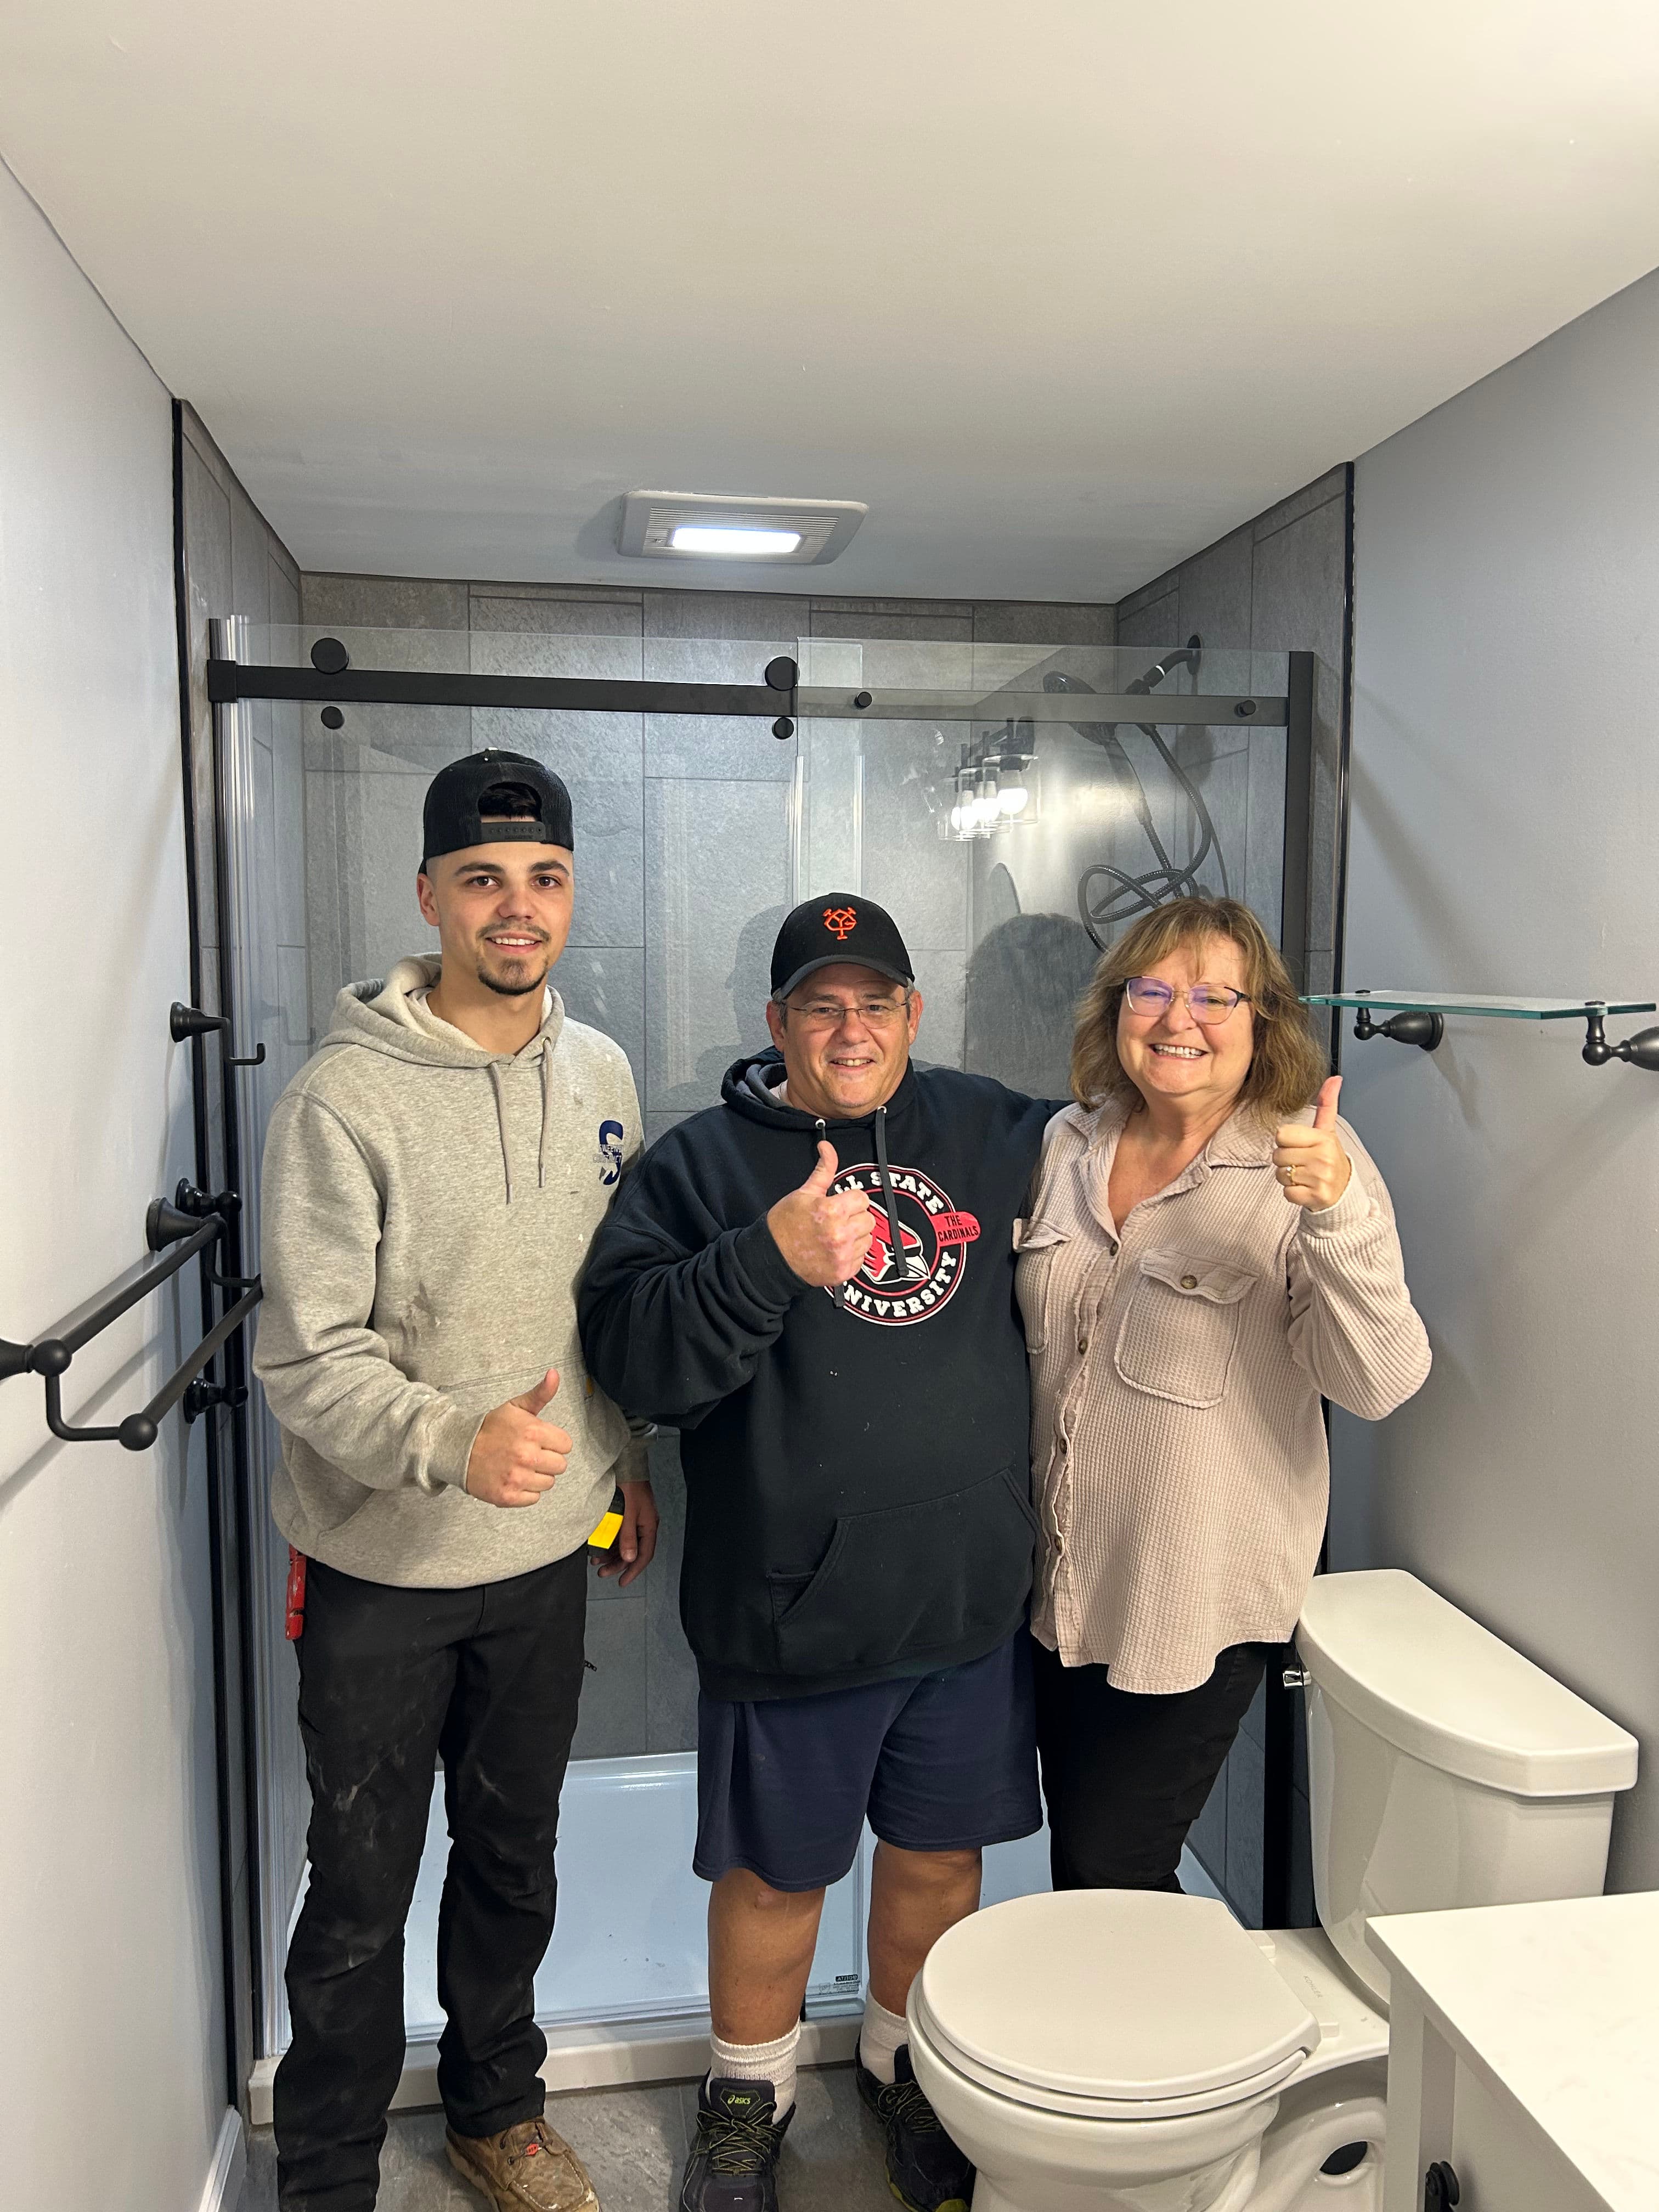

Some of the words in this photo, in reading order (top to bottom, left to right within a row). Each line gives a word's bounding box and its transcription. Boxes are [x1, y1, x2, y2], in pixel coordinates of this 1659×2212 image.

[870, 1171, 944, 1215] STATE
[938, 1225, 979, 1242] CARDINALS
[944, 1215, 963, 1227] THE
[843, 1251, 957, 1317] NIVERSITY
